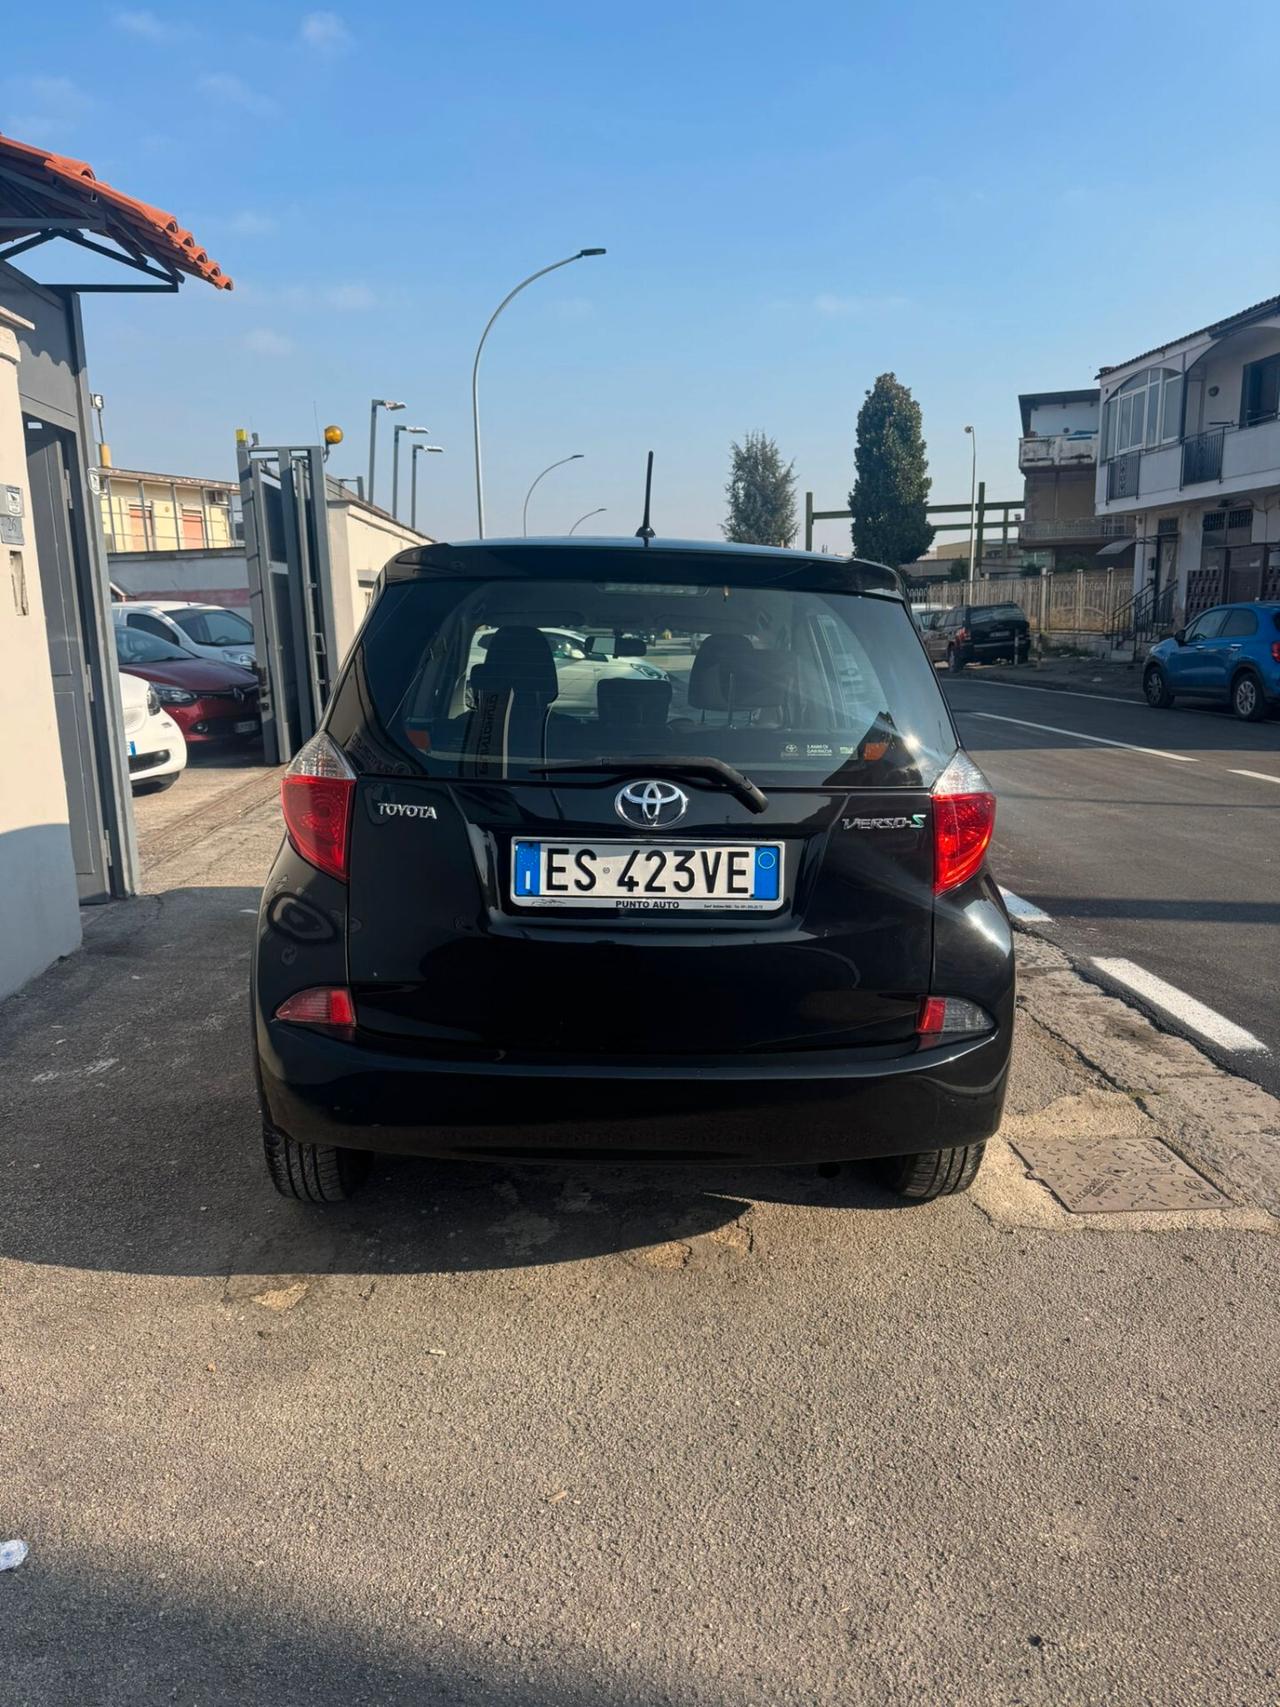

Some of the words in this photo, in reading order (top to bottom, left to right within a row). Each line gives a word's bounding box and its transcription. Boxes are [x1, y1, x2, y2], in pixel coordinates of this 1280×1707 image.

[377, 802, 438, 820] TOYOTA
[841, 814, 927, 830] VERSO-S
[546, 847, 597, 892] ES
[616, 848, 750, 894] 423VE
[615, 900, 650, 909] PUNTO
[652, 901, 680, 909] AUTO
